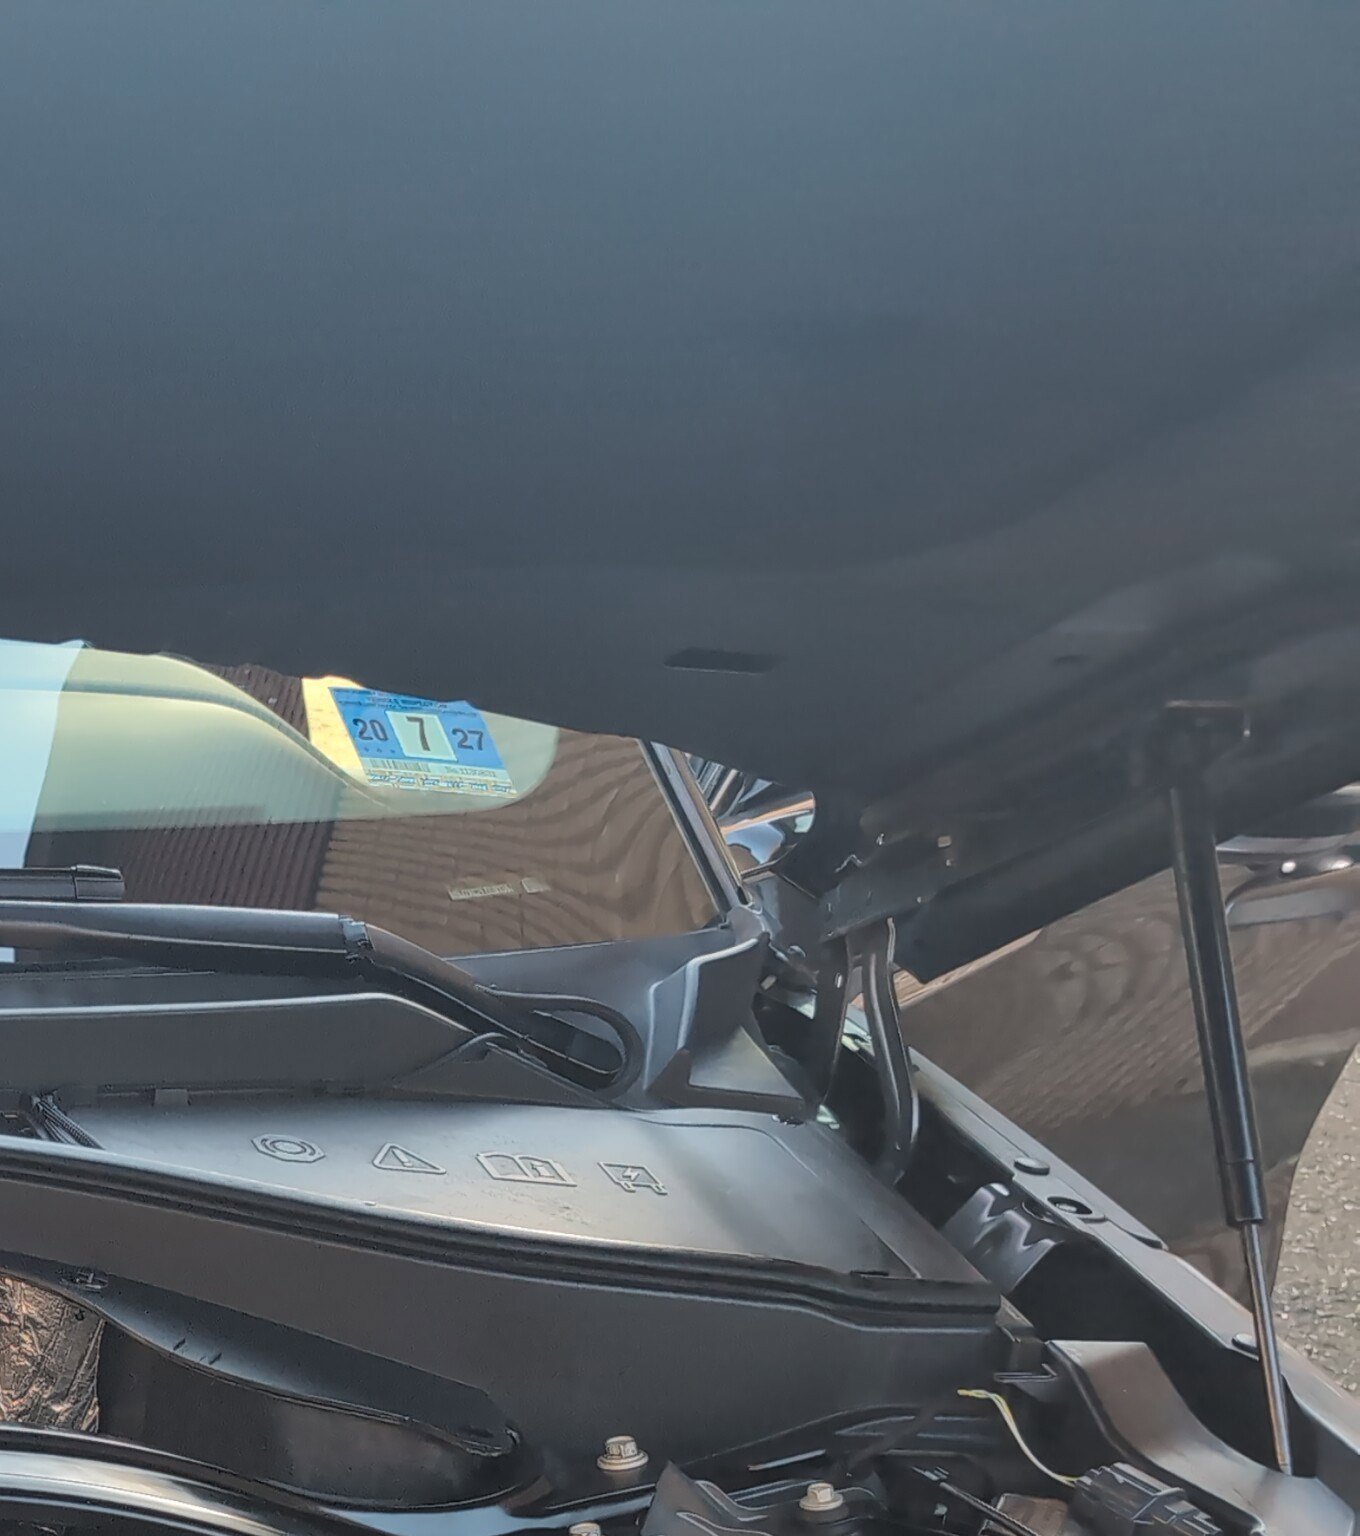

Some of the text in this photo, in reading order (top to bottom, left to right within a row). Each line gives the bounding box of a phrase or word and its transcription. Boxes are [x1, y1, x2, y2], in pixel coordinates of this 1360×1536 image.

[352, 716, 484, 752] 20 7 27
